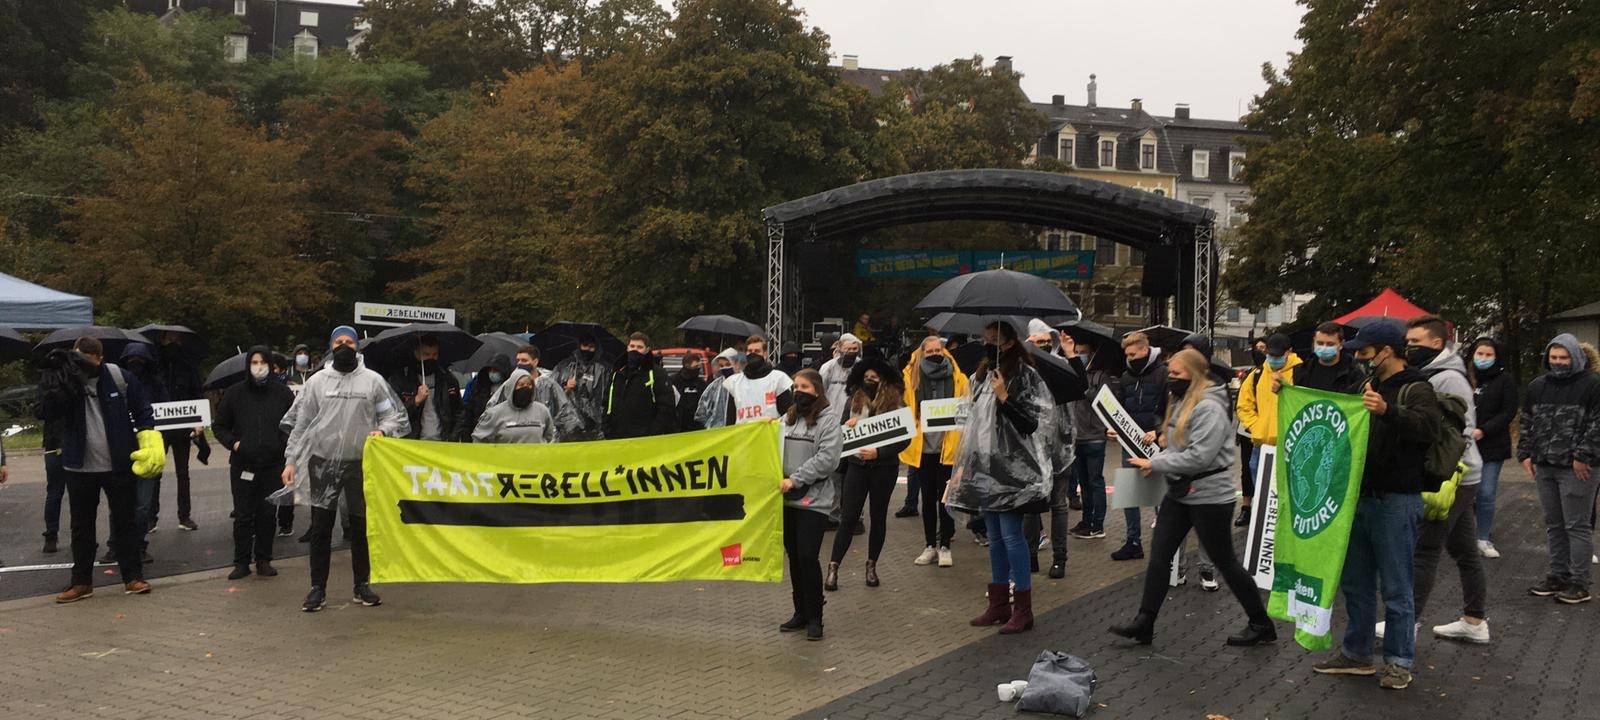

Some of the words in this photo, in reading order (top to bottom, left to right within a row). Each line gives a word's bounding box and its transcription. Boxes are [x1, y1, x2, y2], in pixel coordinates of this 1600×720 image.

[154, 405, 197, 418] LINNEN
[737, 405, 762, 420] WIR
[1284, 403, 1323, 462] FRIDAYS
[1325, 406, 1346, 438] FOR
[1293, 496, 1338, 534] FUTURE
